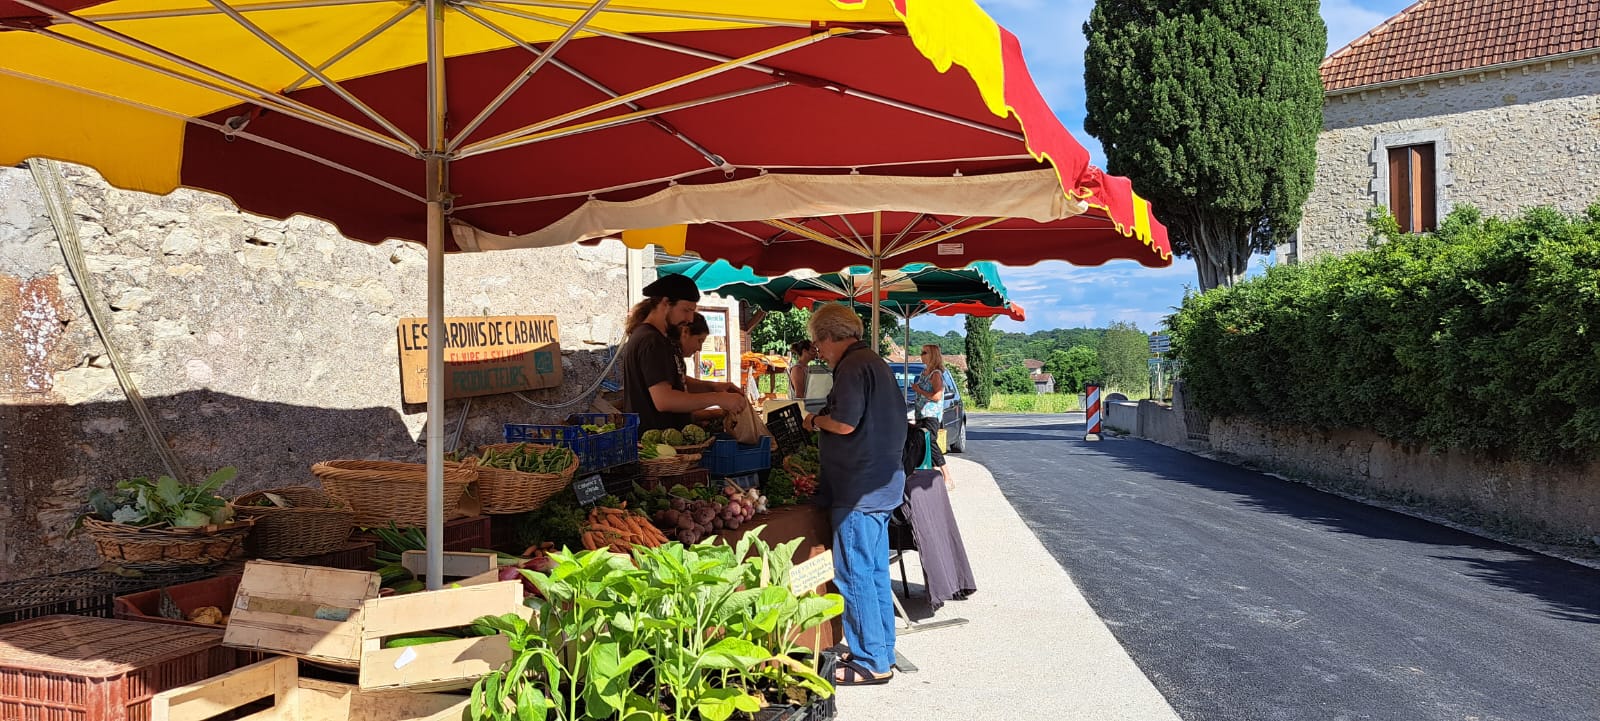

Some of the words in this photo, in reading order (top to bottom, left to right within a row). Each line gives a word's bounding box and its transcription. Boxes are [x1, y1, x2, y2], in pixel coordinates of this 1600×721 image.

[402, 323, 429, 351] LES
[443, 321, 487, 349] ARDINS
[488, 322, 504, 346] DE
[505, 319, 556, 345] CABANAC
[450, 351, 480, 366] ELVIRE
[490, 347, 524, 363] SYLVAIN
[452, 364, 527, 392] PRODUCTEURS
